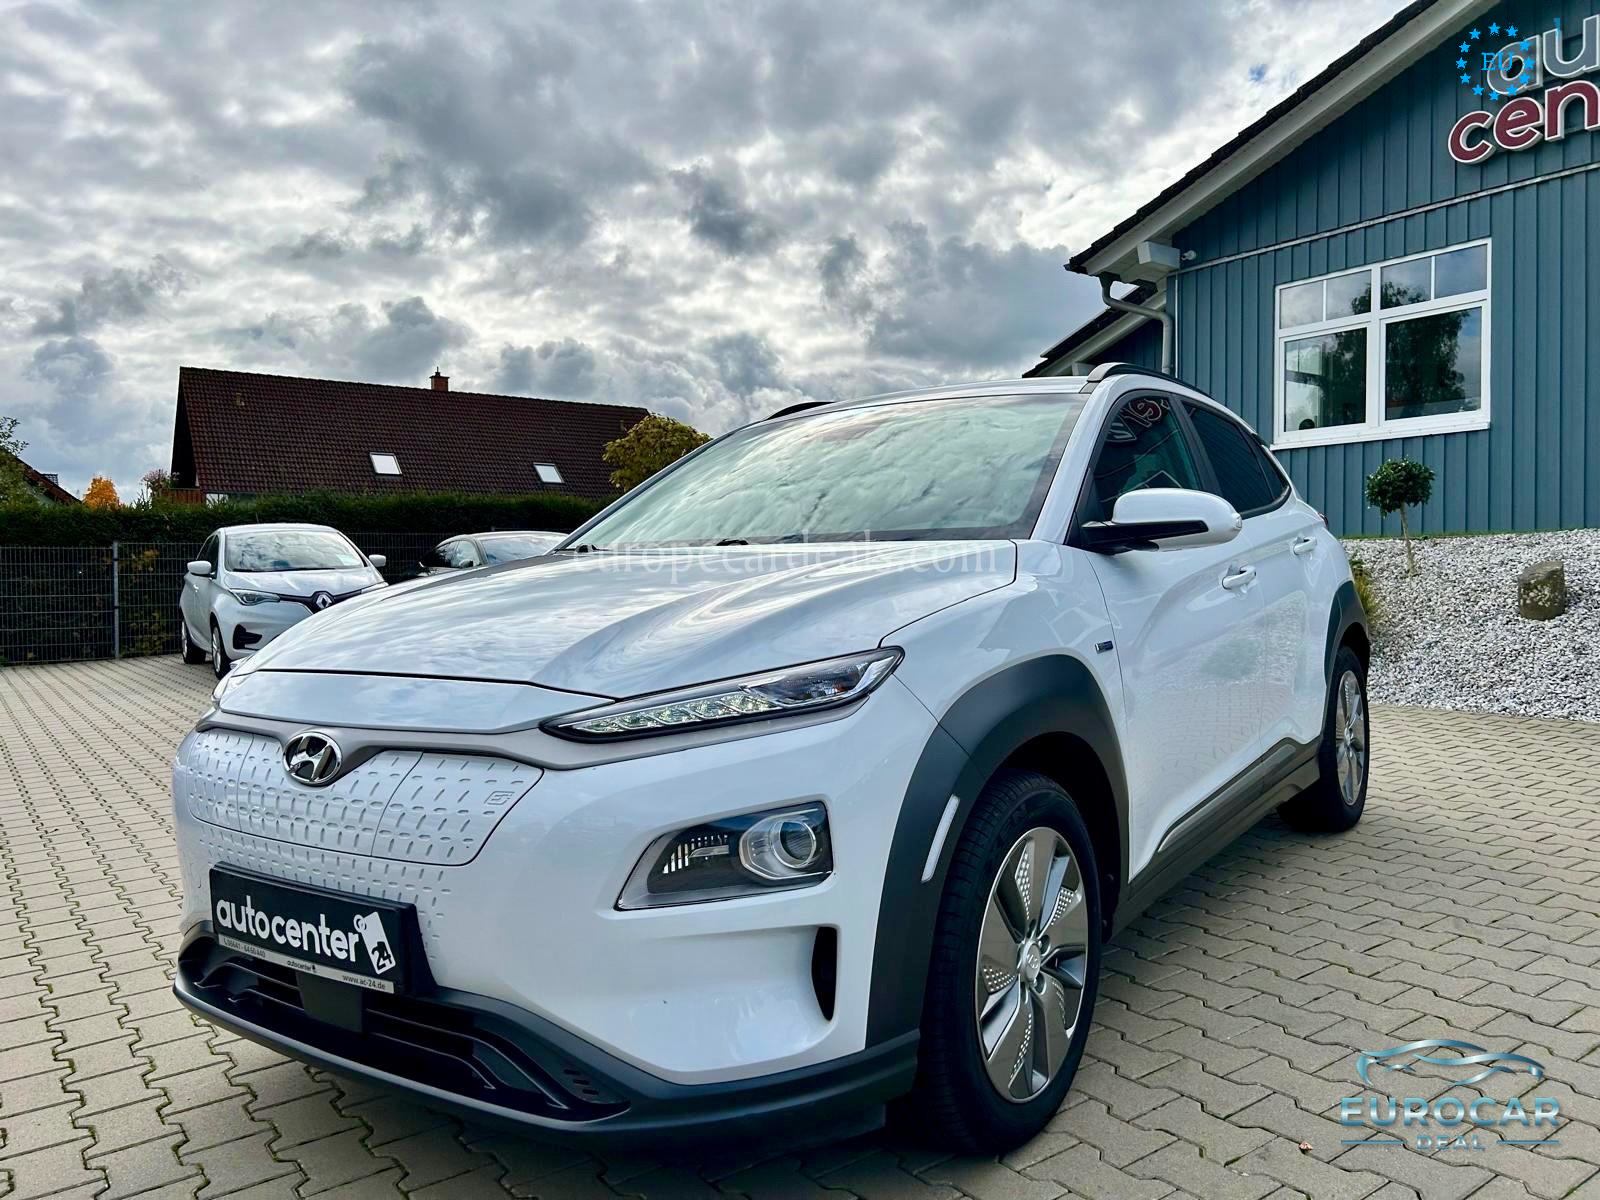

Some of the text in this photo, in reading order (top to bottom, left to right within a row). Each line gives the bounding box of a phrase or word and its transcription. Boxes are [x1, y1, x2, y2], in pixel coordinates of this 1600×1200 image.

[216, 894, 391, 970] autocenter 24
[342, 974, 386, 990] www.ac-24.de
